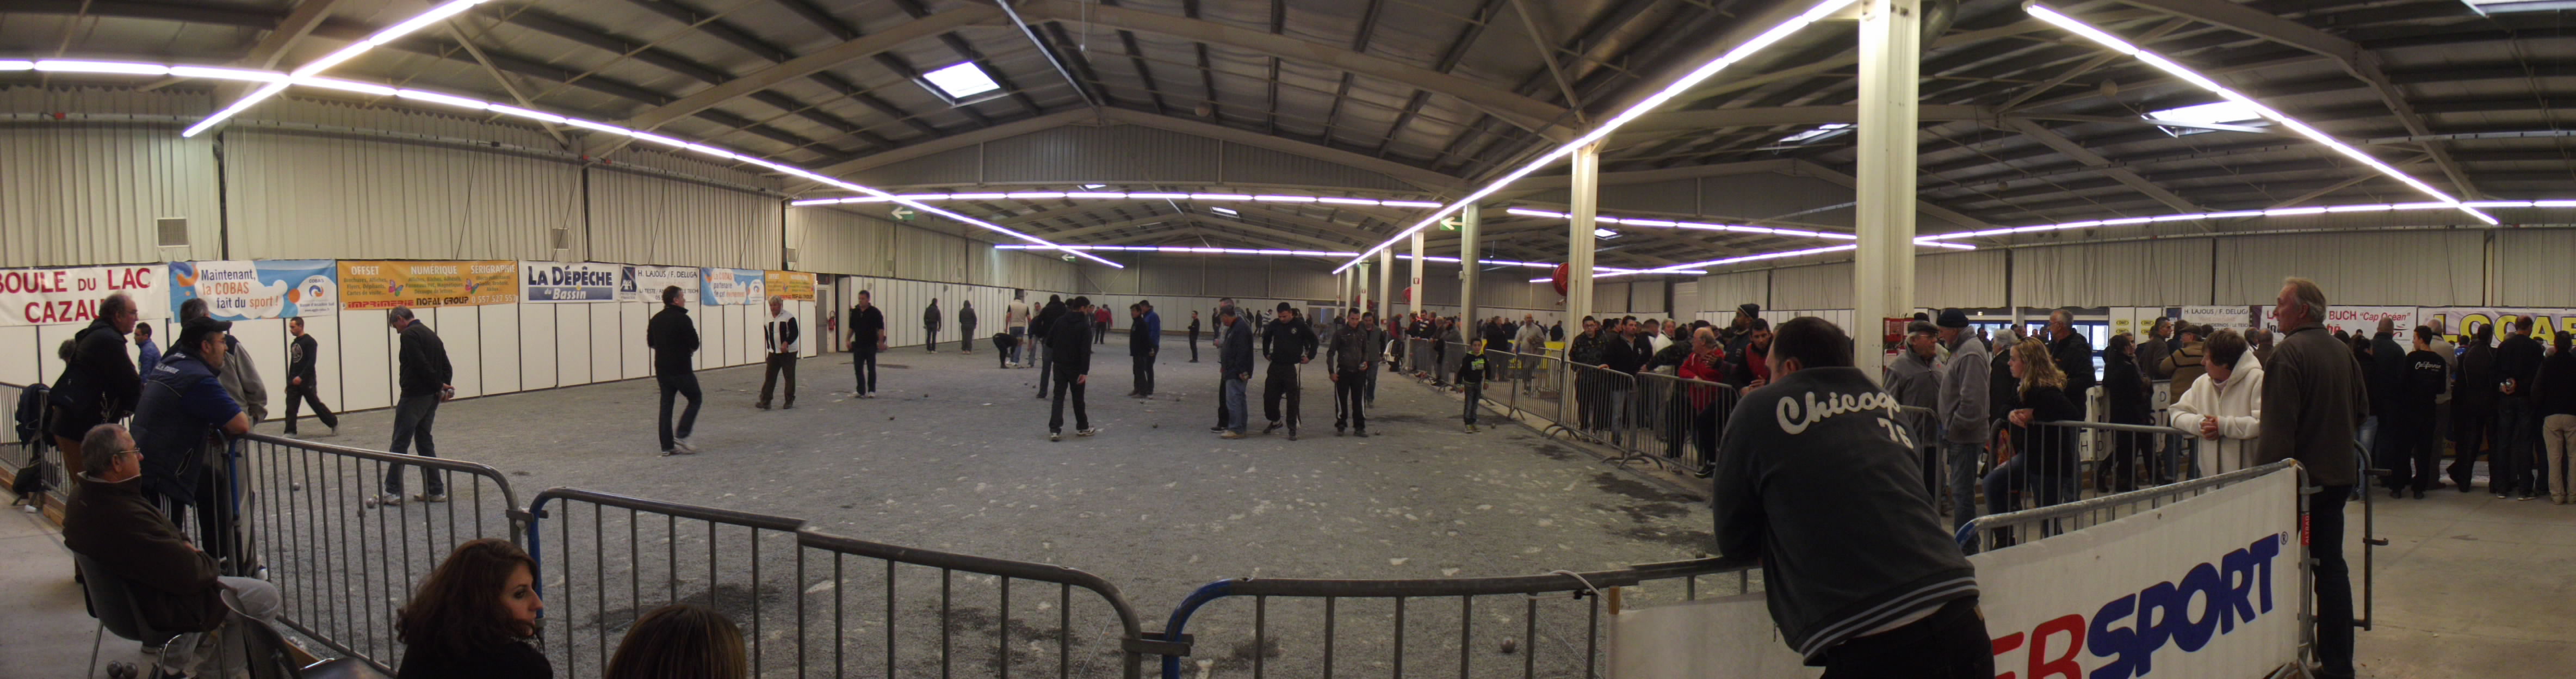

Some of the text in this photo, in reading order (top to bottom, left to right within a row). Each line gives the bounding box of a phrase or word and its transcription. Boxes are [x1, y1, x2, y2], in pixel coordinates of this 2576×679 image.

[201, 269, 256, 281] Maintenant,
[351, 264, 515, 275] OFFSET NUMÉRIQUE SÉRIGRAPHIE
[552, 265, 612, 286] DÉPÊCHE
[0, 268, 151, 294] OULE DU LAC
[620, 279, 633, 291] AXA
[202, 282, 249, 295] la COBAS
[553, 288, 586, 300] Bassin
[217, 298, 232, 309] fait
[235, 298, 246, 308] du
[250, 296, 273, 310] sport
[2329, 311, 2357, 320] BUCH
[1877, 417, 1914, 449] 76
